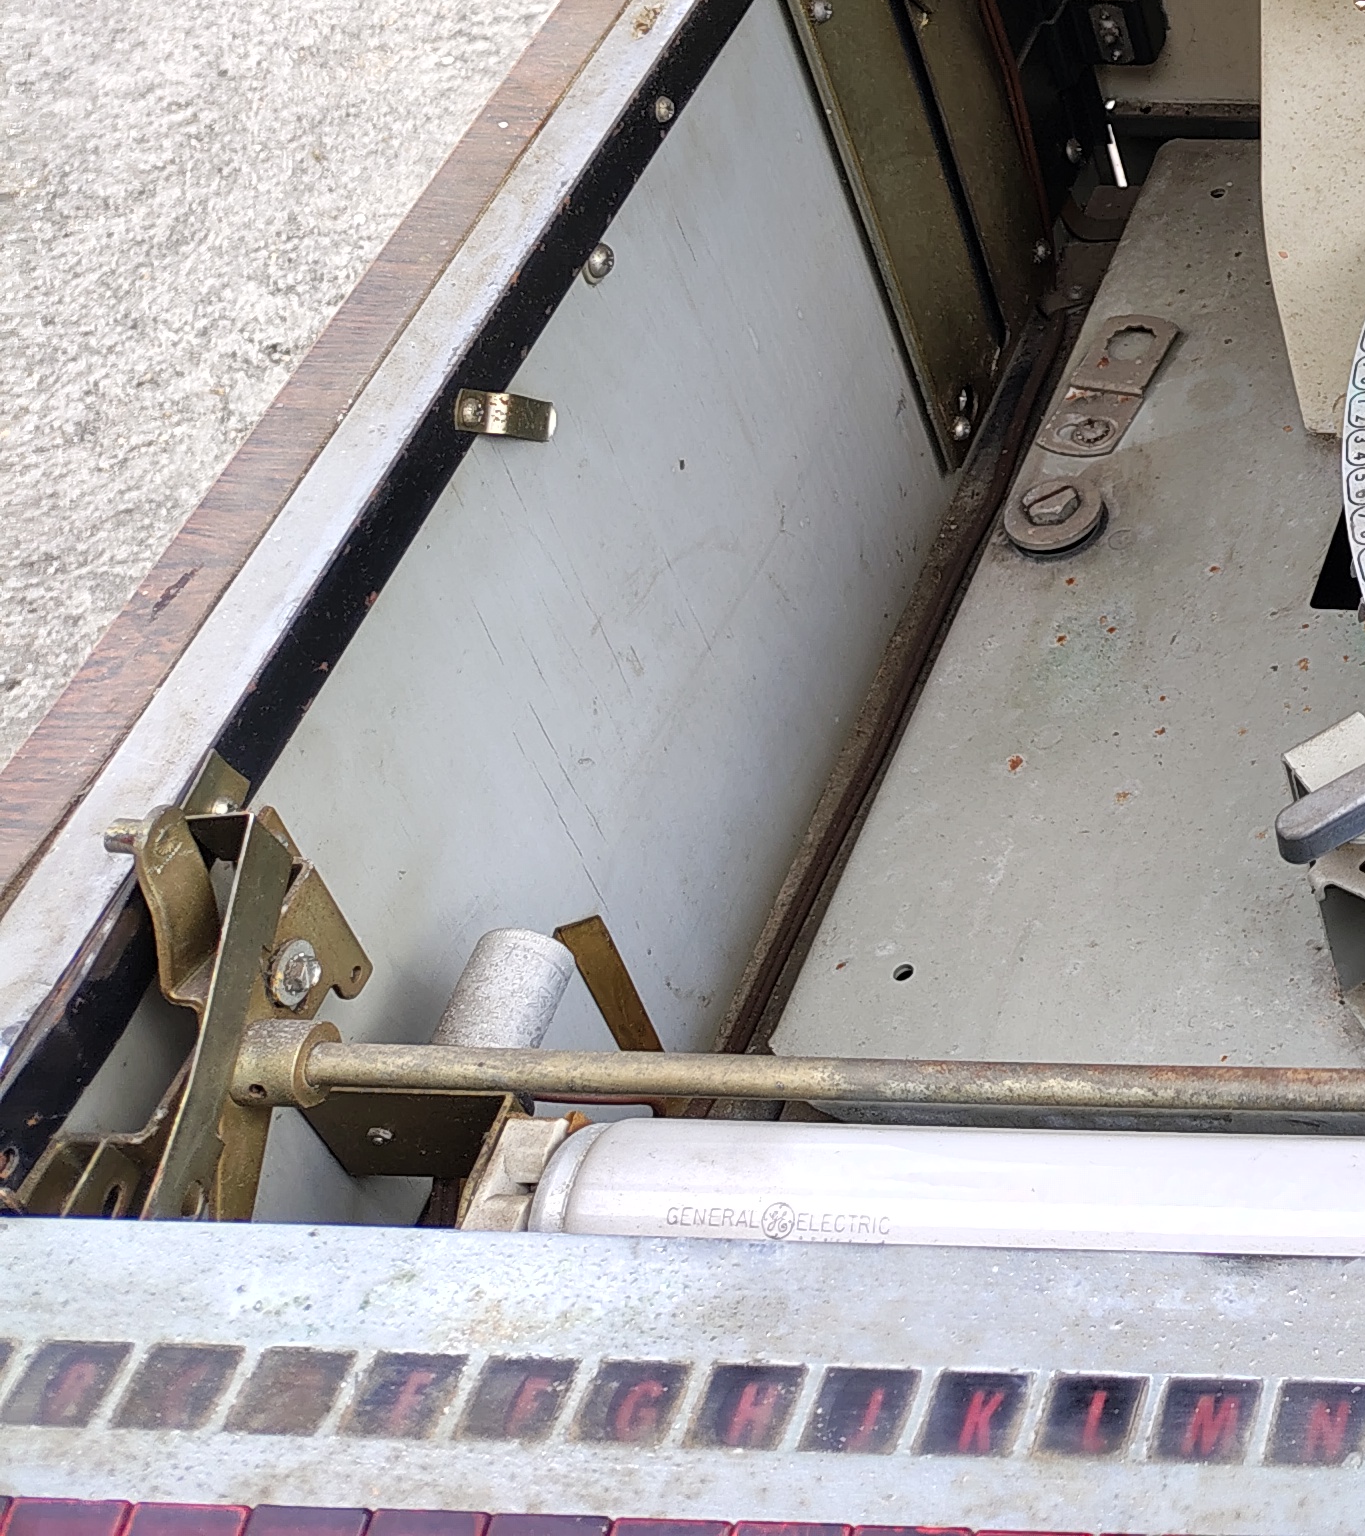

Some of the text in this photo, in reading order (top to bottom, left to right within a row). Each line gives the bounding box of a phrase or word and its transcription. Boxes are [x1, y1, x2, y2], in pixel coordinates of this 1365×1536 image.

[666, 1206, 759, 1229] GENERAL
[796, 1212, 891, 1236] ELECTRIC
[615, 1380, 663, 1440] G
[729, 1381, 776, 1444] H
[843, 1387, 883, 1448] J
[960, 1390, 1003, 1452] K
[1180, 1395, 1237, 1456] M
[1308, 1399, 1349, 1460] N
